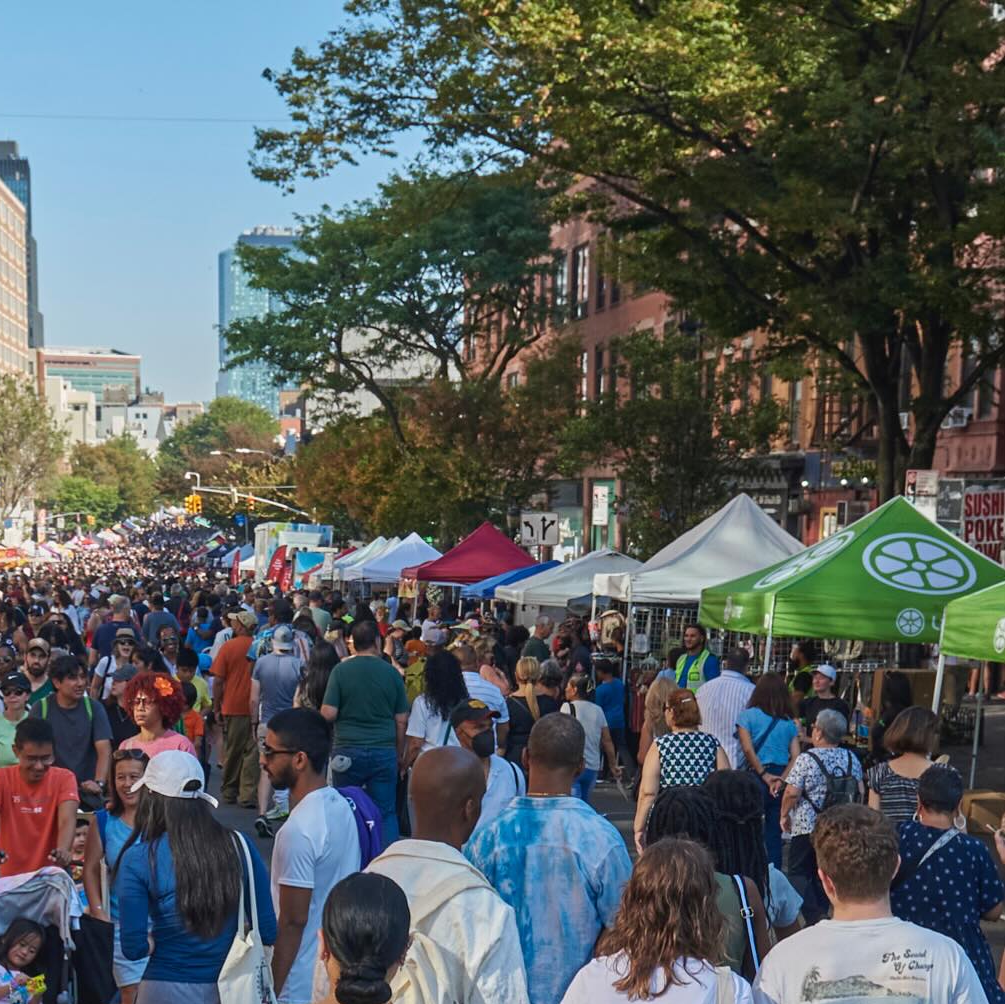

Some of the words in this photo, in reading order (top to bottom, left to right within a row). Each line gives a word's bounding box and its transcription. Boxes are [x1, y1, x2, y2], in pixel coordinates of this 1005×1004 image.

[965, 492, 1004, 516] SUSHI
[965, 518, 1004, 543] POKE
[882, 951, 901, 964] The
[903, 948, 927, 959] Sound
[893, 961, 906, 975] Of
